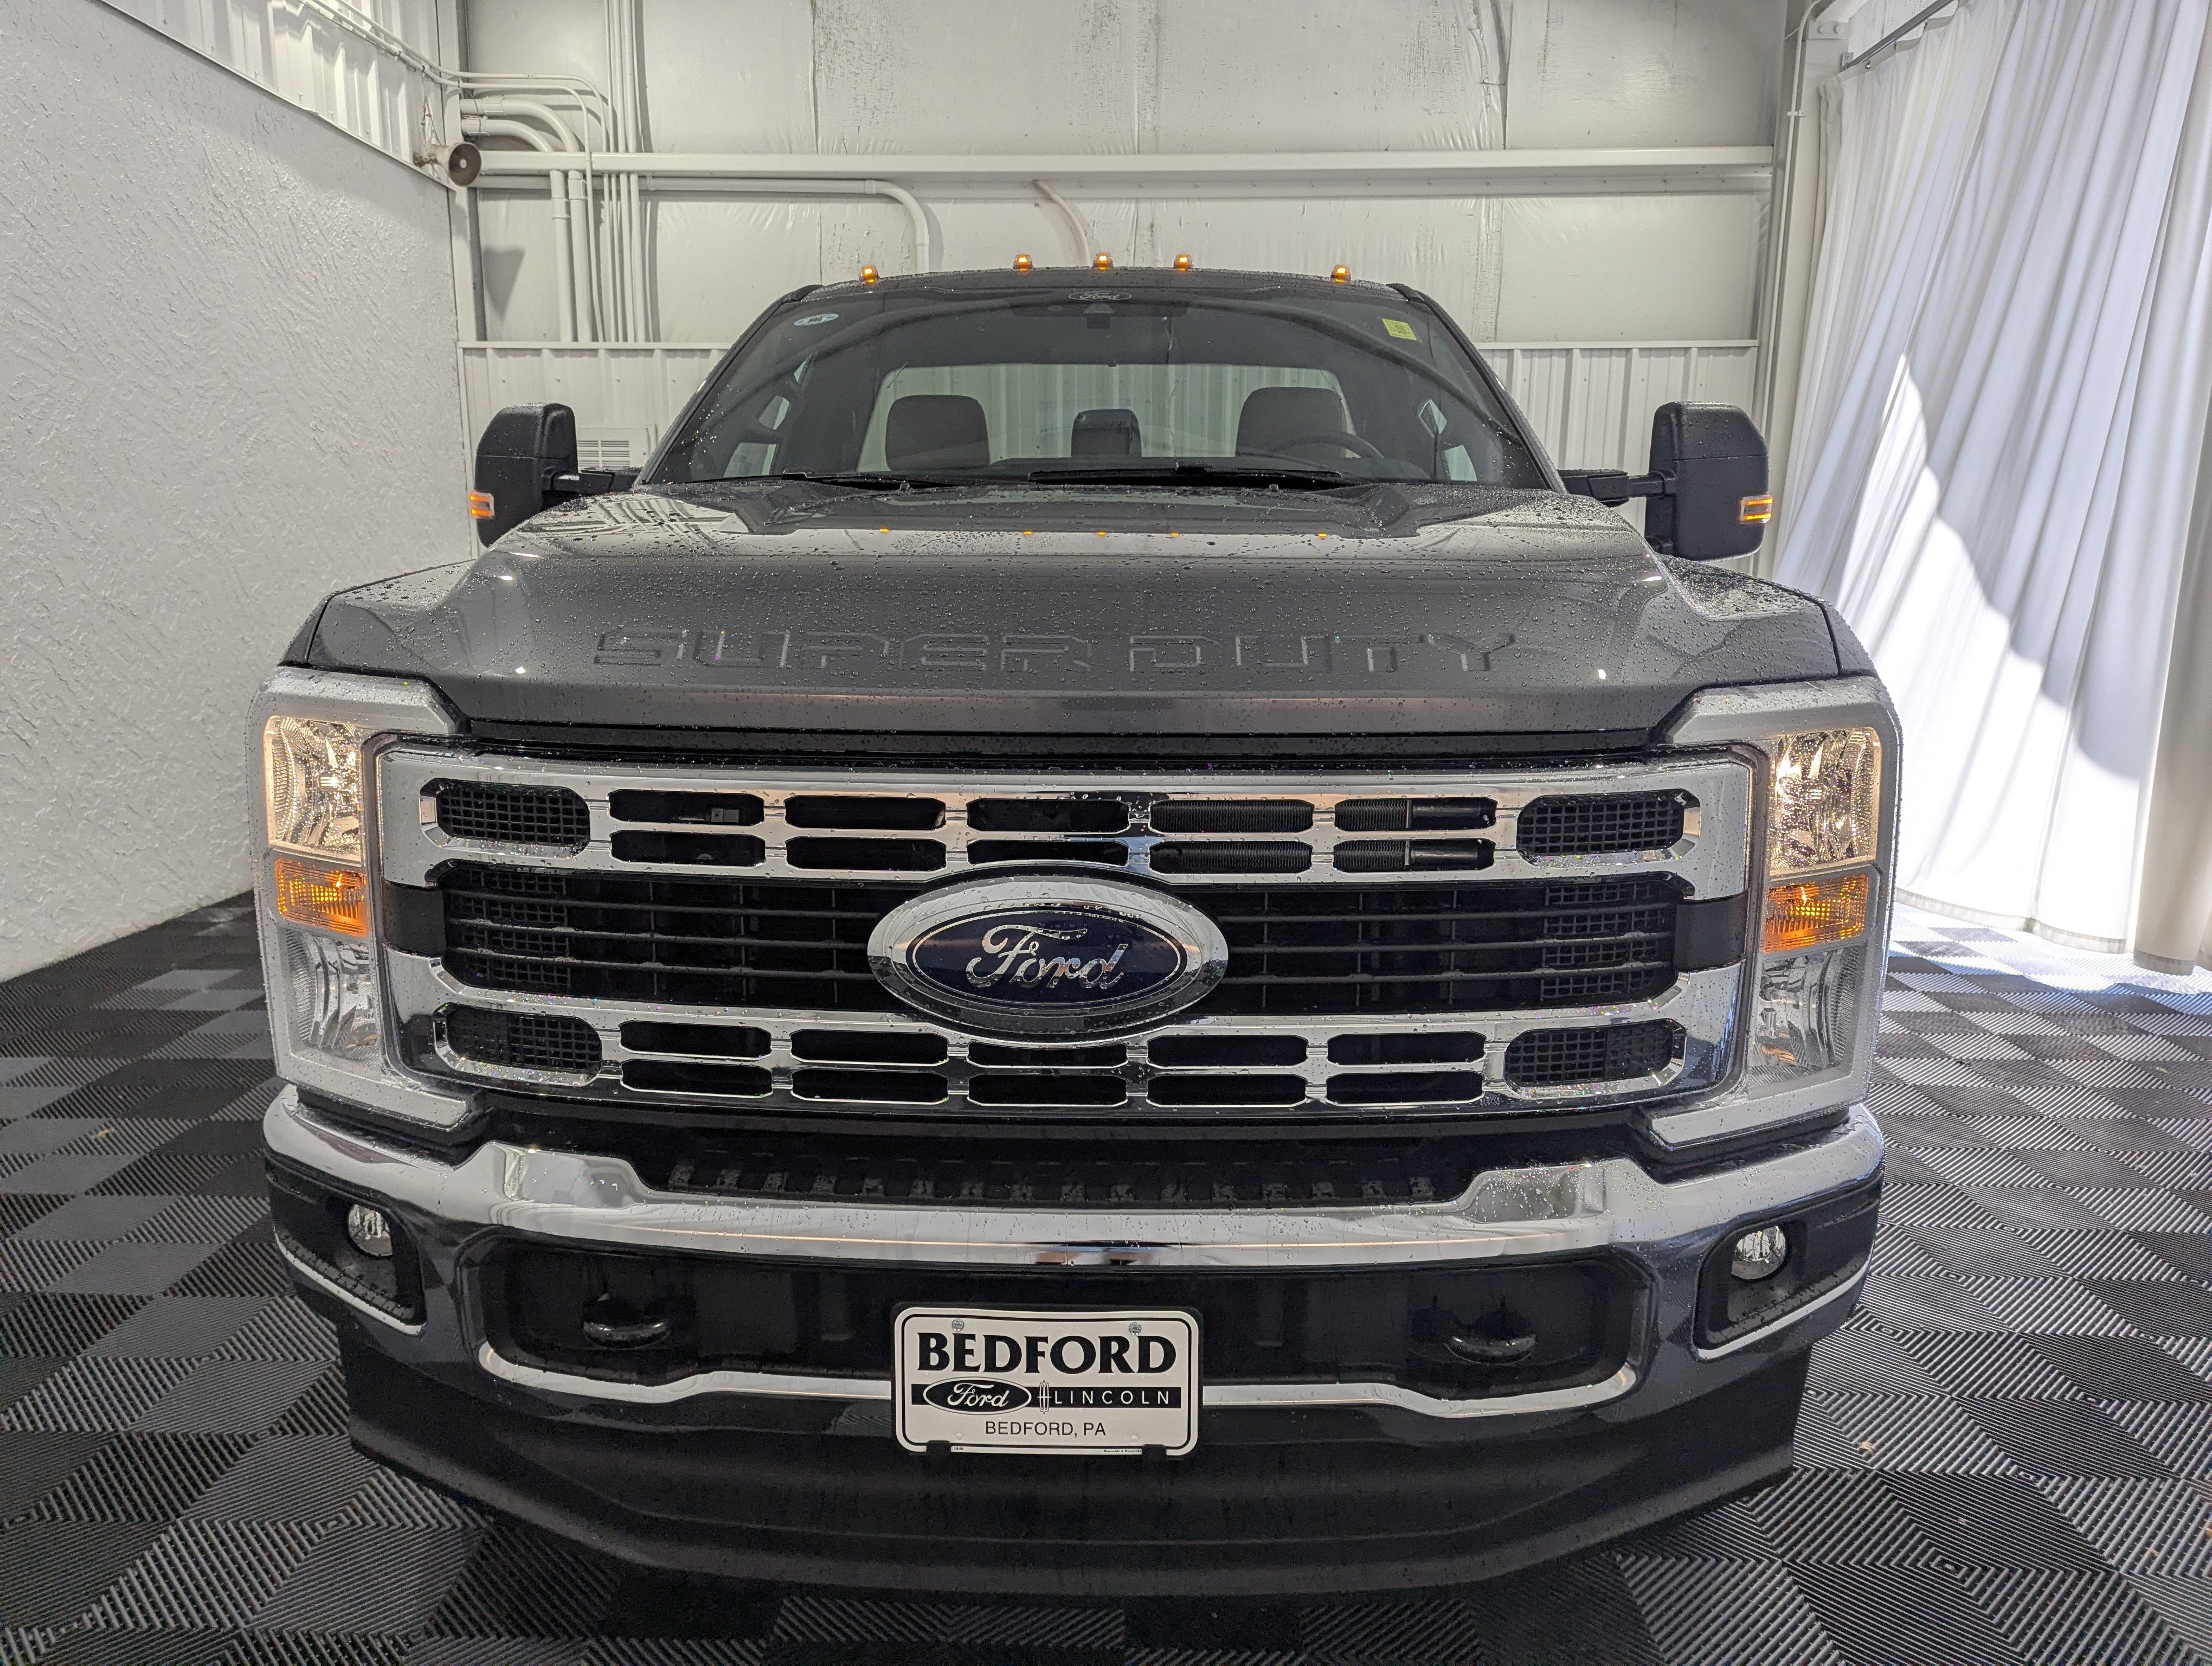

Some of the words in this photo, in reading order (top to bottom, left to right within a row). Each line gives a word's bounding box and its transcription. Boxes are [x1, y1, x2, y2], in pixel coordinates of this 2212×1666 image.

[1079, 291, 1121, 299] Ford
[594, 625, 1091, 671] SUPER
[1129, 631, 1516, 672] DUTY
[966, 924, 1128, 989] Ford
[917, 1332, 1176, 1374] BEDFORD
[947, 1383, 1009, 1408] Ford
[1054, 1391, 1169, 1405] LINCOLN
[986, 1421, 1077, 1438] BEDFORD,
[1084, 1422, 1107, 1437] PA
